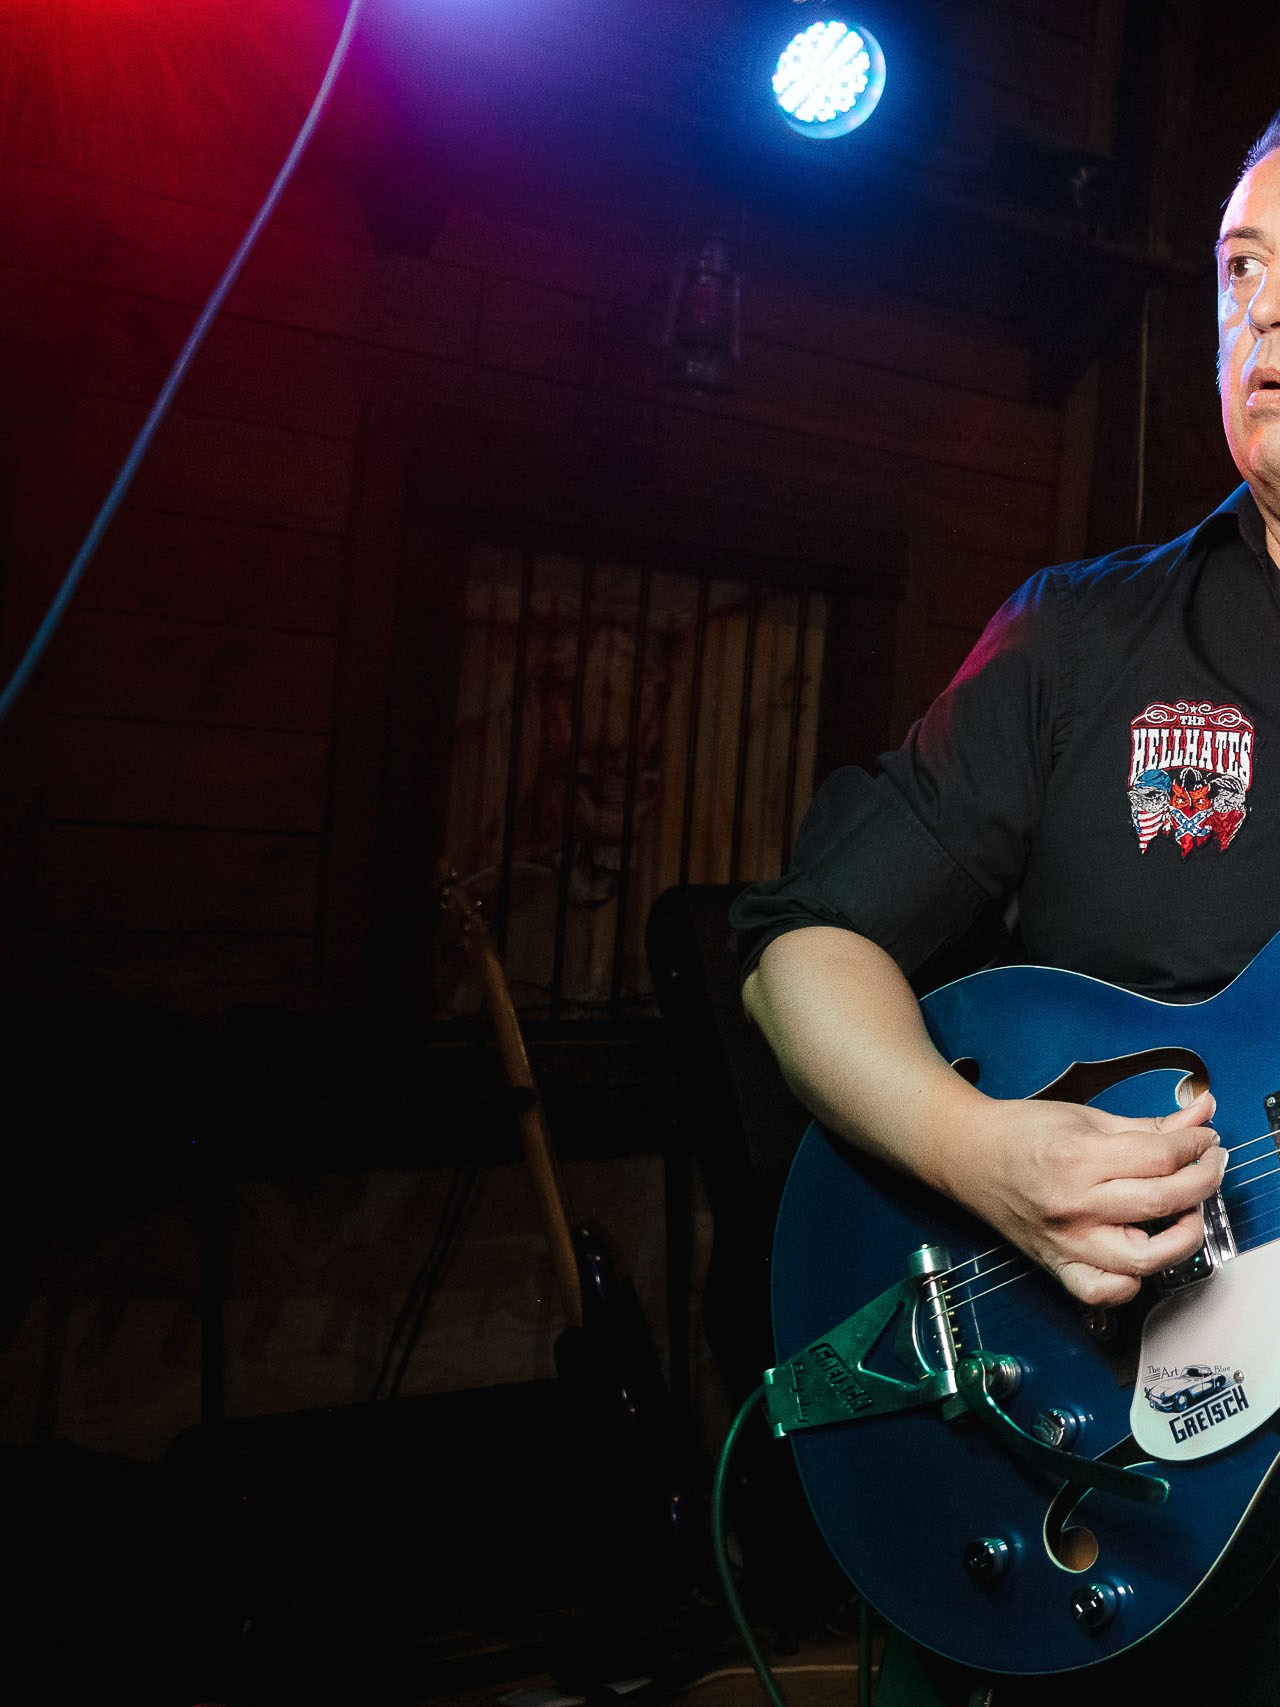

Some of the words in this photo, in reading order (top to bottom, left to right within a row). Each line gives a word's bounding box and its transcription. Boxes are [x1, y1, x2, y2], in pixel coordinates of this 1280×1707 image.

[1179, 715, 1206, 726] THE
[1129, 728, 1253, 788] HELLHATES
[1147, 1365, 1161, 1375] The
[1161, 1366, 1179, 1379] Art
[1168, 1385, 1250, 1444] GRETSCH
